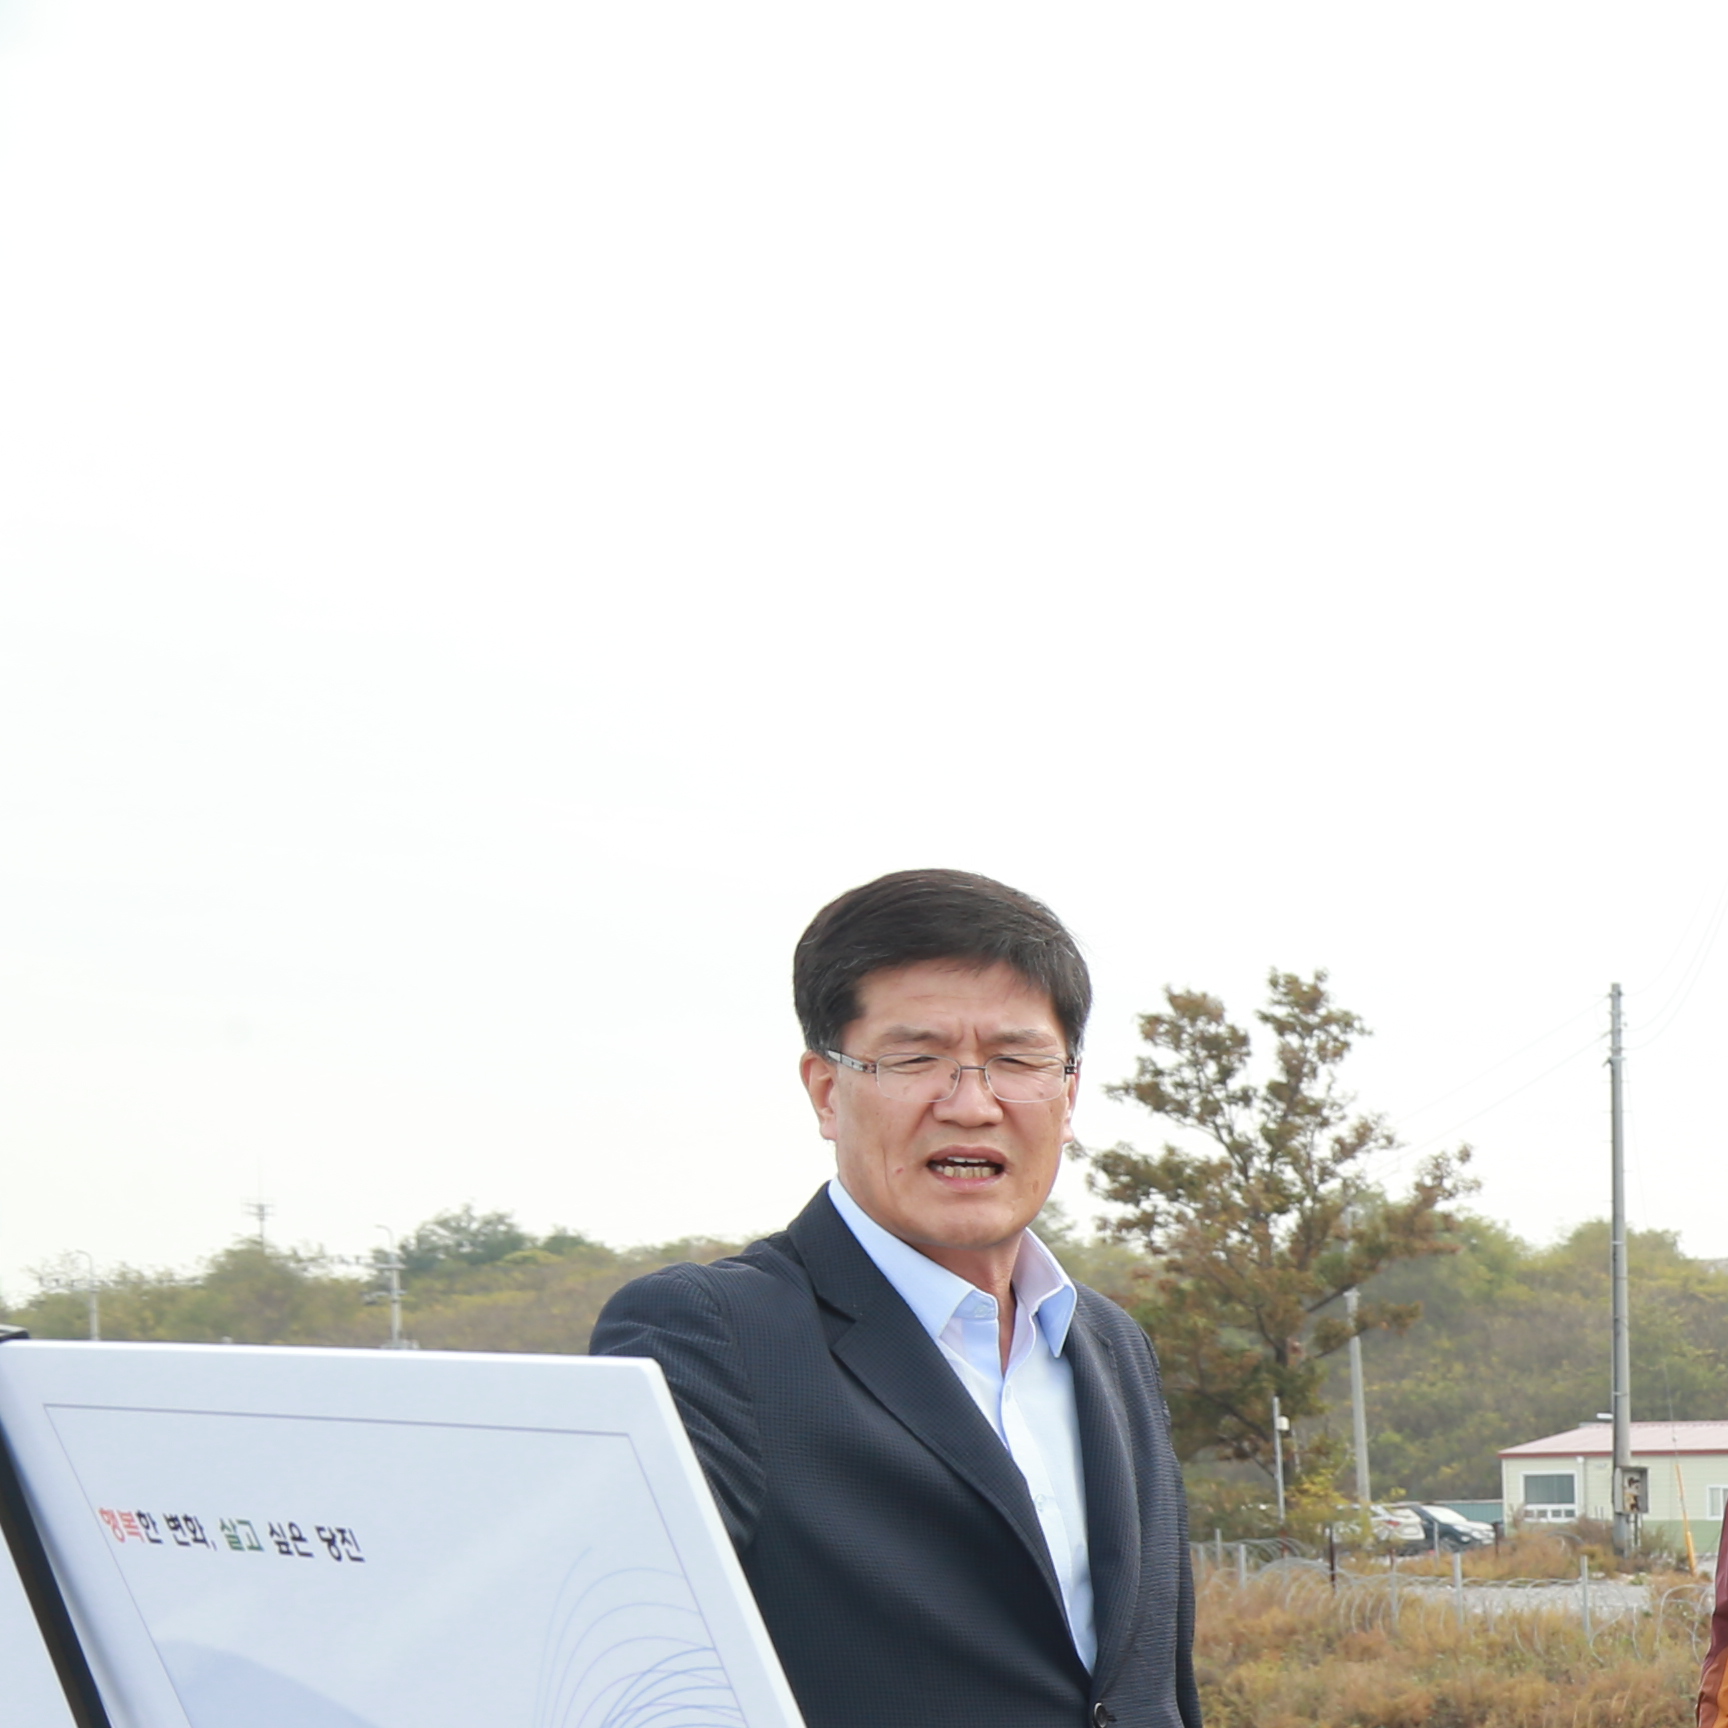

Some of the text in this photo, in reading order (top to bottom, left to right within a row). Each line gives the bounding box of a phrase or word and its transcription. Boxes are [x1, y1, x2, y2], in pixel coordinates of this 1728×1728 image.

[98, 1507, 164, 1545] 행복한
[219, 1517, 266, 1552] 살고
[268, 1521, 315, 1558] 싶은
[314, 1525, 366, 1563] 당진
